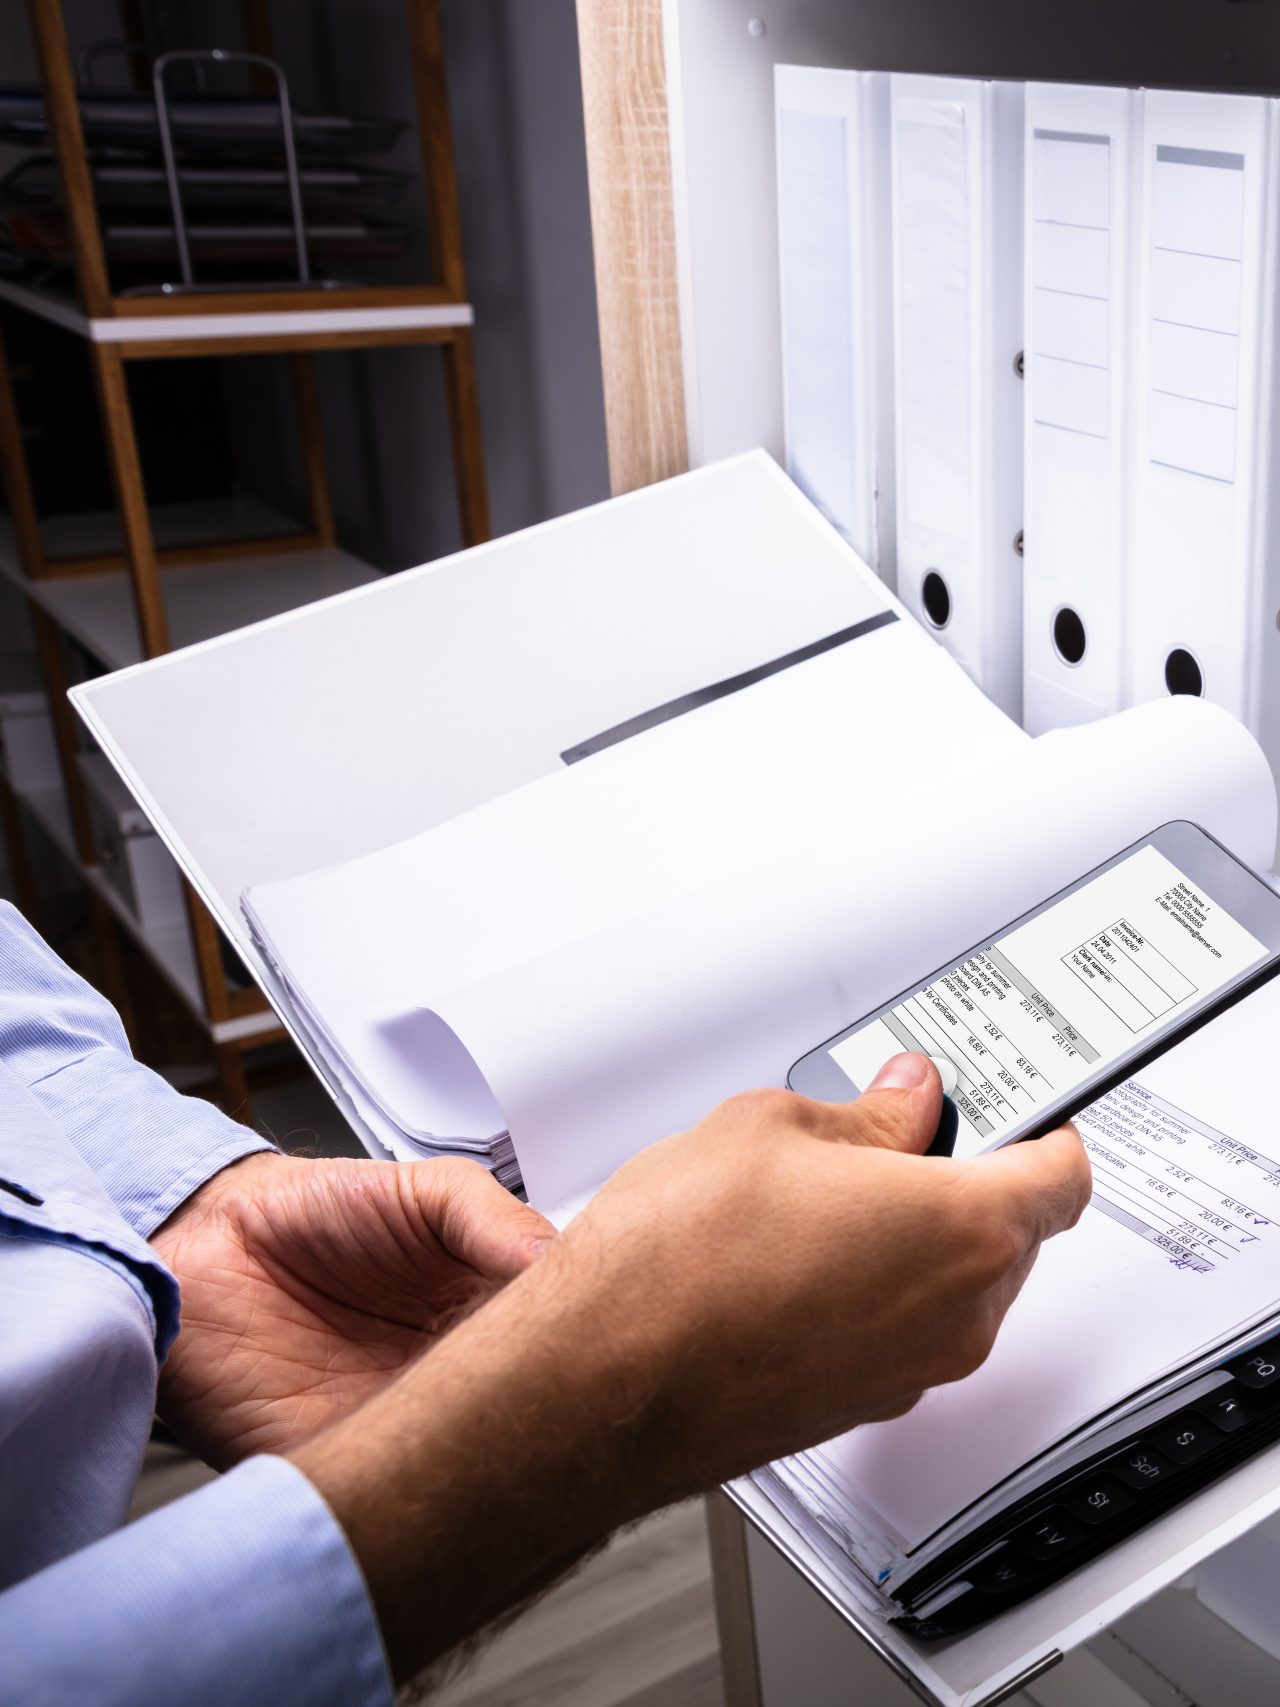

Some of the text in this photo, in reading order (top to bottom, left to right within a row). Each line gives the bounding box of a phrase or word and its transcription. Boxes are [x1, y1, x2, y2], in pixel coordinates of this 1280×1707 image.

[1177, 882, 1193, 896] Street
[1170, 887, 1207, 922] 70000 City Name
[1171, 899, 1185, 912] 0000
[1099, 935, 1111, 947] Date
[1111, 926, 1140, 953] 2011042401
[1119, 921, 1144, 947] Invoice-Nr.
[1078, 949, 1092, 963] Clerk
[1091, 940, 1117, 964] 24.04.2011
[984, 962, 994, 971] for
[990, 969, 1011, 989] summer
[1071, 954, 1096, 979] Your Name
[951, 975, 970, 992] pieces
[971, 977, 984, 989] DIN
[979, 988, 991, 997] A5
[978, 972, 992, 982] and
[986, 981, 1006, 1001] printing
[940, 977, 974, 1012] photo on white
[925, 990, 935, 999] for
[932, 997, 961, 1026] Certificates
[1019, 999, 1039, 1018] 273,11
[1031, 992, 1055, 1017] Unit Price
[984, 1023, 999, 1037] 2,52
[1063, 1025, 1078, 1041] Price
[967, 1036, 983, 1052] 16,80
[1052, 1033, 1072, 1052] 273,11
[1016, 1057, 1033, 1074] 83,16
[997, 1070, 1015, 1087] 20,00
[969, 1089, 986, 1106] 51,89
[980, 1081, 1001, 1101] 273,11
[1124, 1082, 1156, 1100] Service
[957, 1097, 978, 1117] 325,00
[1099, 1103, 1164, 1142] cardboard DIN A5
[1099, 1114, 1113, 1123] 50
[1106, 1121, 1135, 1138] pieces
[1119, 1104, 1145, 1120] design
[1143, 1118, 1161, 1129] and
[1156, 1127, 1186, 1145] printing
[1149, 1109, 1162, 1118] for
[1159, 1116, 1191, 1135] summer
[1092, 1123, 1116, 1138] photo
[1114, 1136, 1126, 1144] on
[1125, 1142, 1146, 1156] white
[1220, 1137, 1258, 1161] Unit Price
[1083, 1143, 1127, 1169] Certificates
[1208, 1143, 1237, 1160] 273,11
[1165, 1166, 1186, 1179] 2,52
[1145, 1178, 1169, 1193] 16,80
[1220, 1198, 1247, 1214] 83,16
[1198, 1210, 1225, 1227] 20,00
[1166, 1228, 1192, 1245] 51,89
[1178, 1221, 1209, 1240] 273,11
[1153, 1235, 1184, 1255] 325,00
[1245, 1356, 1276, 1378] PQ
[1176, 1431, 1195, 1447] S
[1128, 1454, 1161, 1479] Sch
[1087, 1491, 1110, 1509] St
